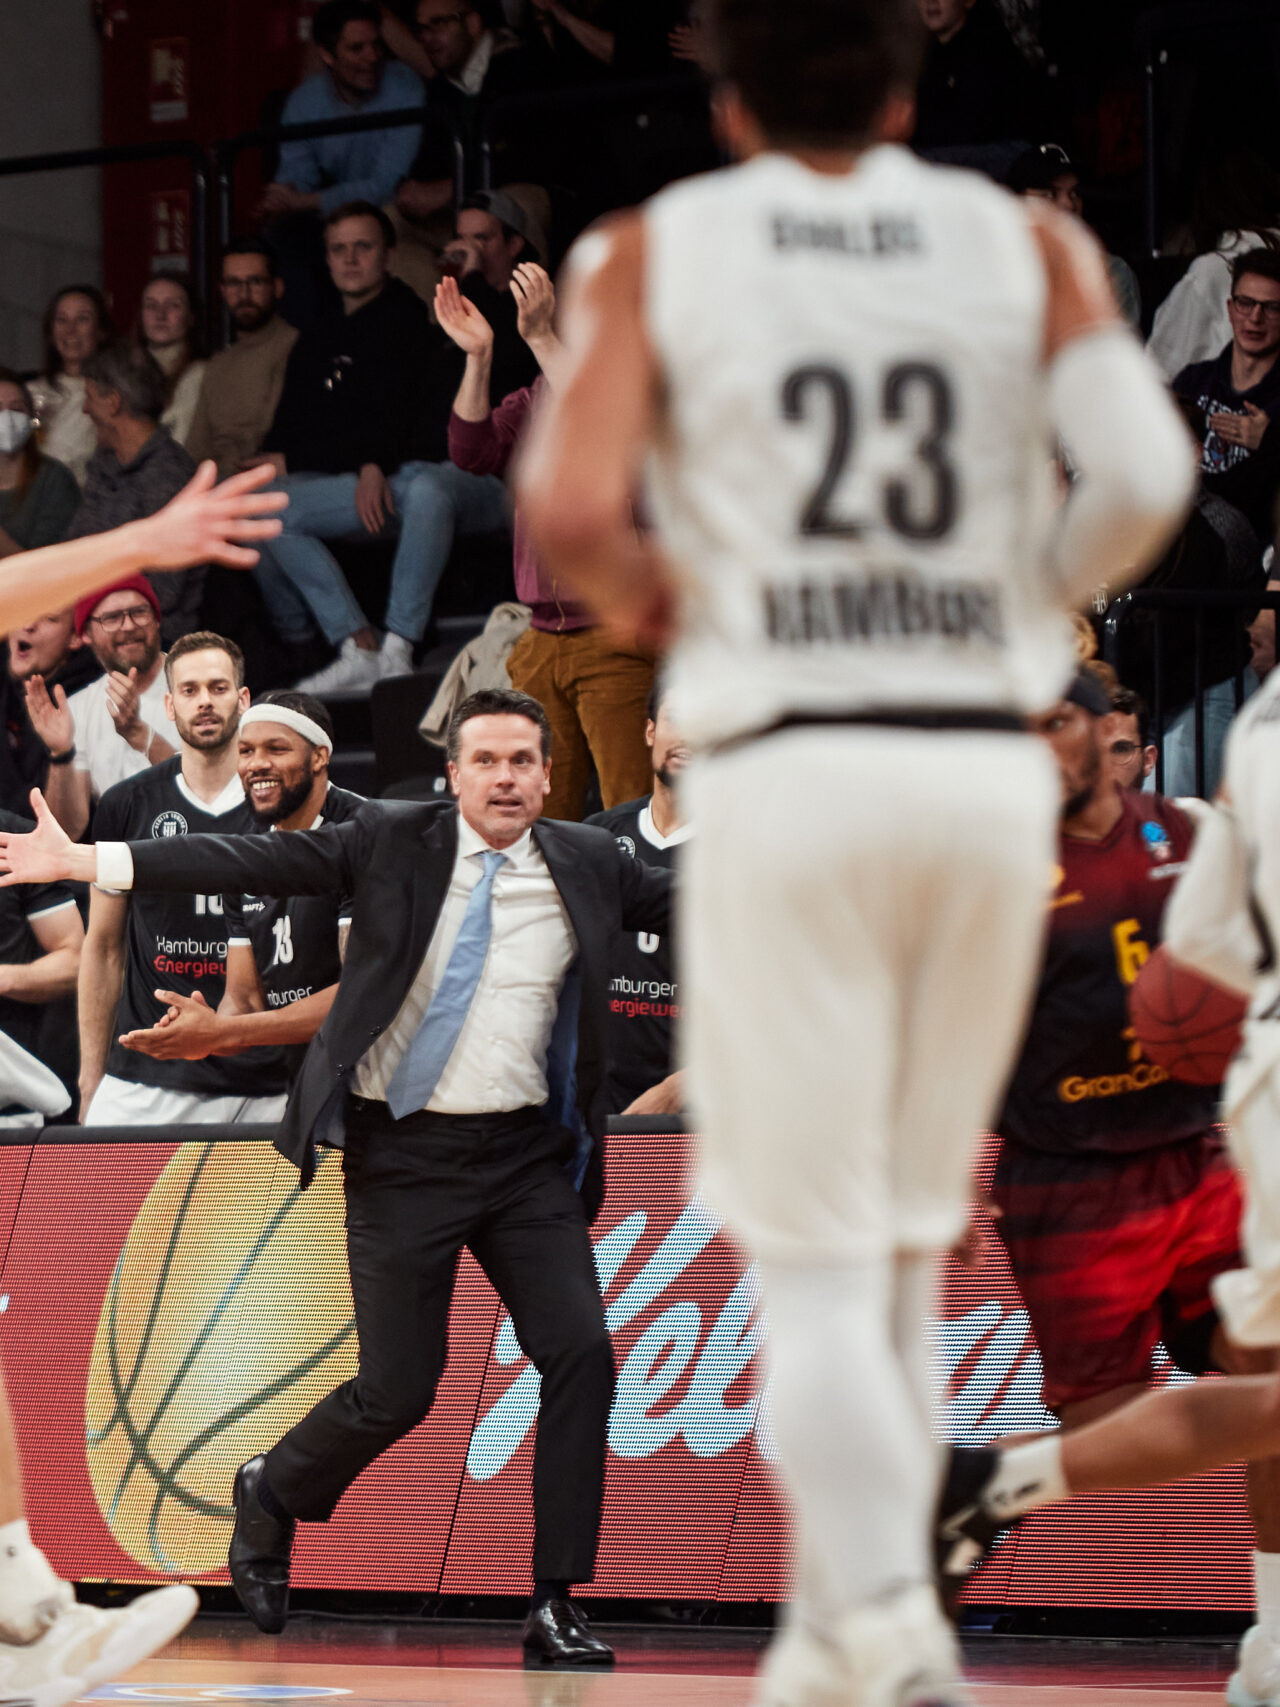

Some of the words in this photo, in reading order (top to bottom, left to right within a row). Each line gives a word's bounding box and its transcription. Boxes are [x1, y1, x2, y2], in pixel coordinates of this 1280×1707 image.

[781, 362, 956, 541] 23
[156, 935, 228, 959] Hamburg
[1059, 1063, 1169, 1104] GranCa
